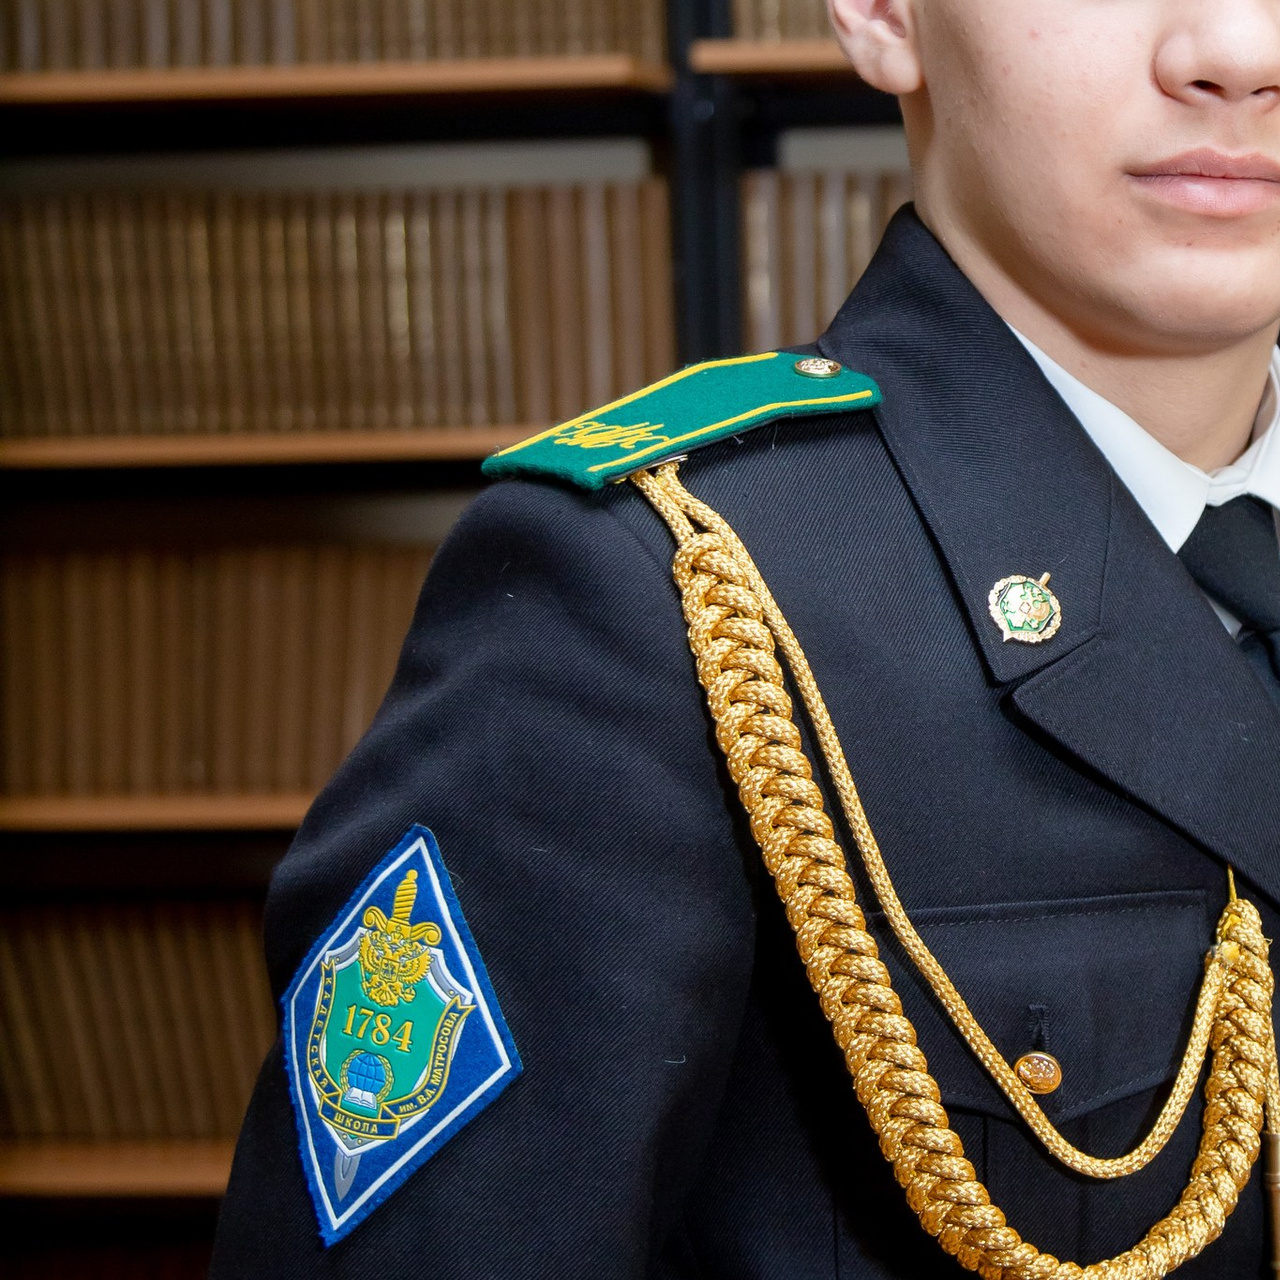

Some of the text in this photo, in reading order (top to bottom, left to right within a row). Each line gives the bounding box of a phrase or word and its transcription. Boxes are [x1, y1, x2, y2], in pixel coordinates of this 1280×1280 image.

[310, 976, 333, 1088] КАДЕТСКАЯ
[342, 1004, 414, 1053] 1784
[429, 1011, 460, 1086] МАТРОСОВА
[333, 1112, 379, 1134] ШКОЛА
